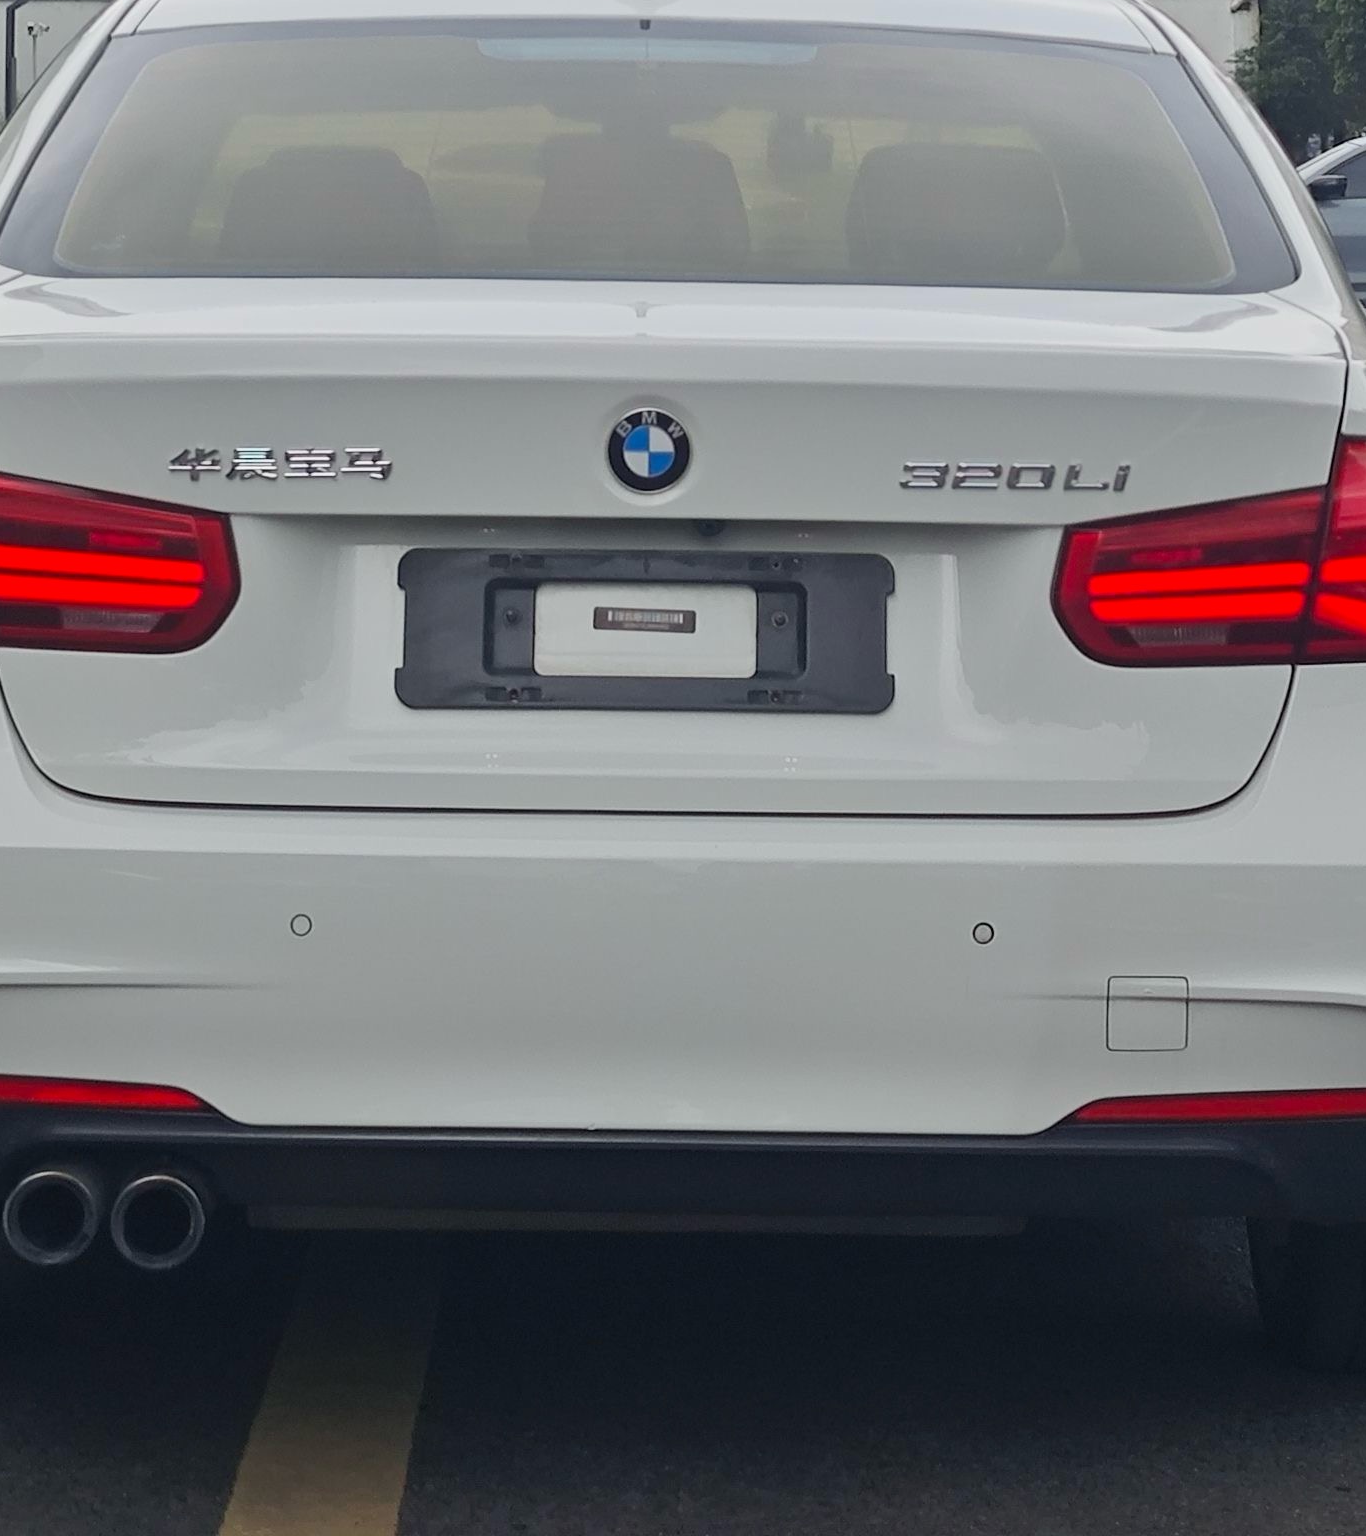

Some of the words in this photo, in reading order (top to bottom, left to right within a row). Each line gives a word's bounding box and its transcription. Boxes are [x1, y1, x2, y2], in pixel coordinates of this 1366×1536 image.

[615, 411, 685, 439] BMW
[167, 447, 393, 482] 华晨宝马
[899, 461, 1131, 492] 320Li
